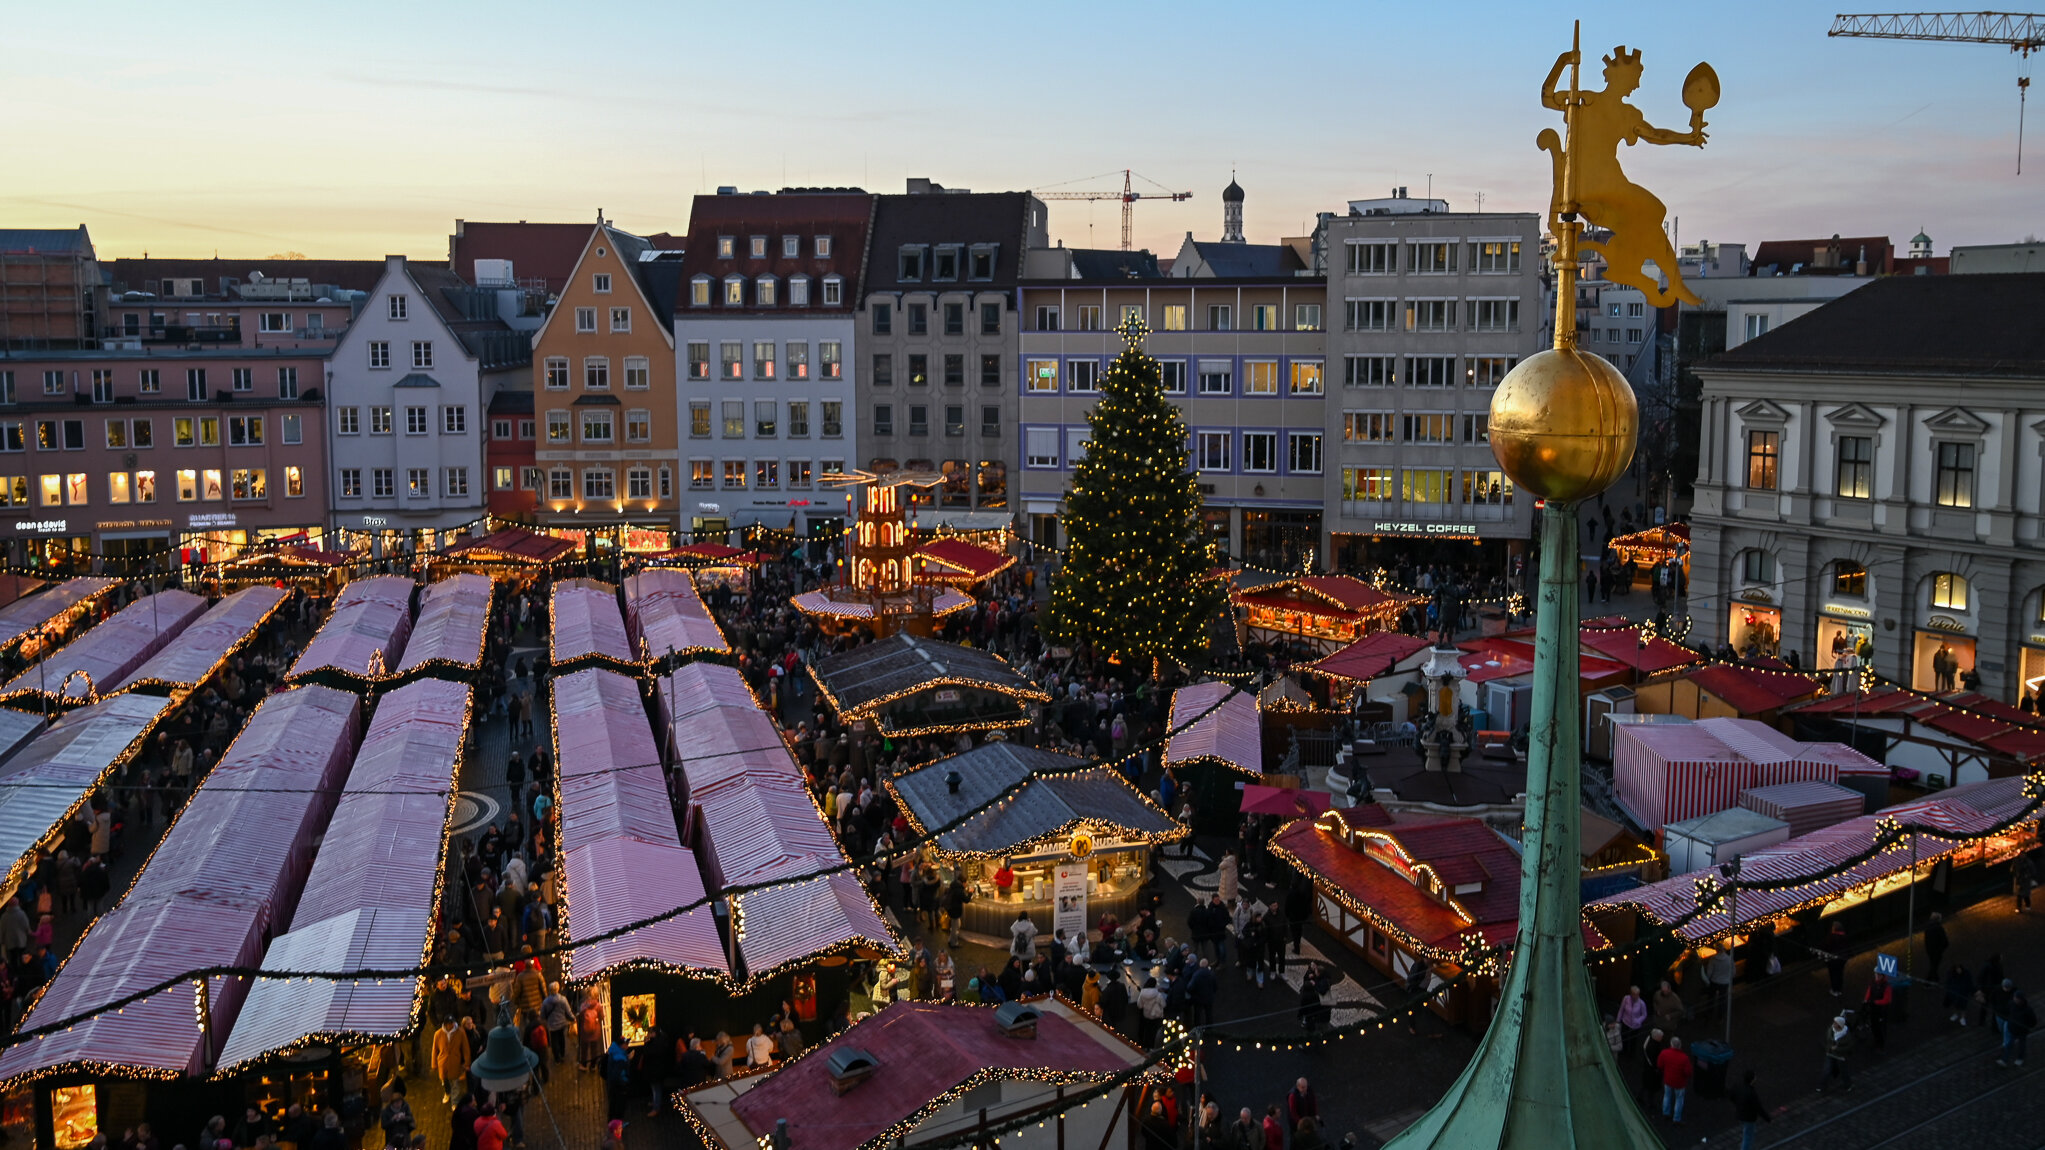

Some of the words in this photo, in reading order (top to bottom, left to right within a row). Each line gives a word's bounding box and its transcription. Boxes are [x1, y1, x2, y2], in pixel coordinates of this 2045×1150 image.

[1374, 522, 1422, 532] HEYZEL
[1426, 524, 1476, 534] COFFEE
[1878, 955, 1896, 973] W
